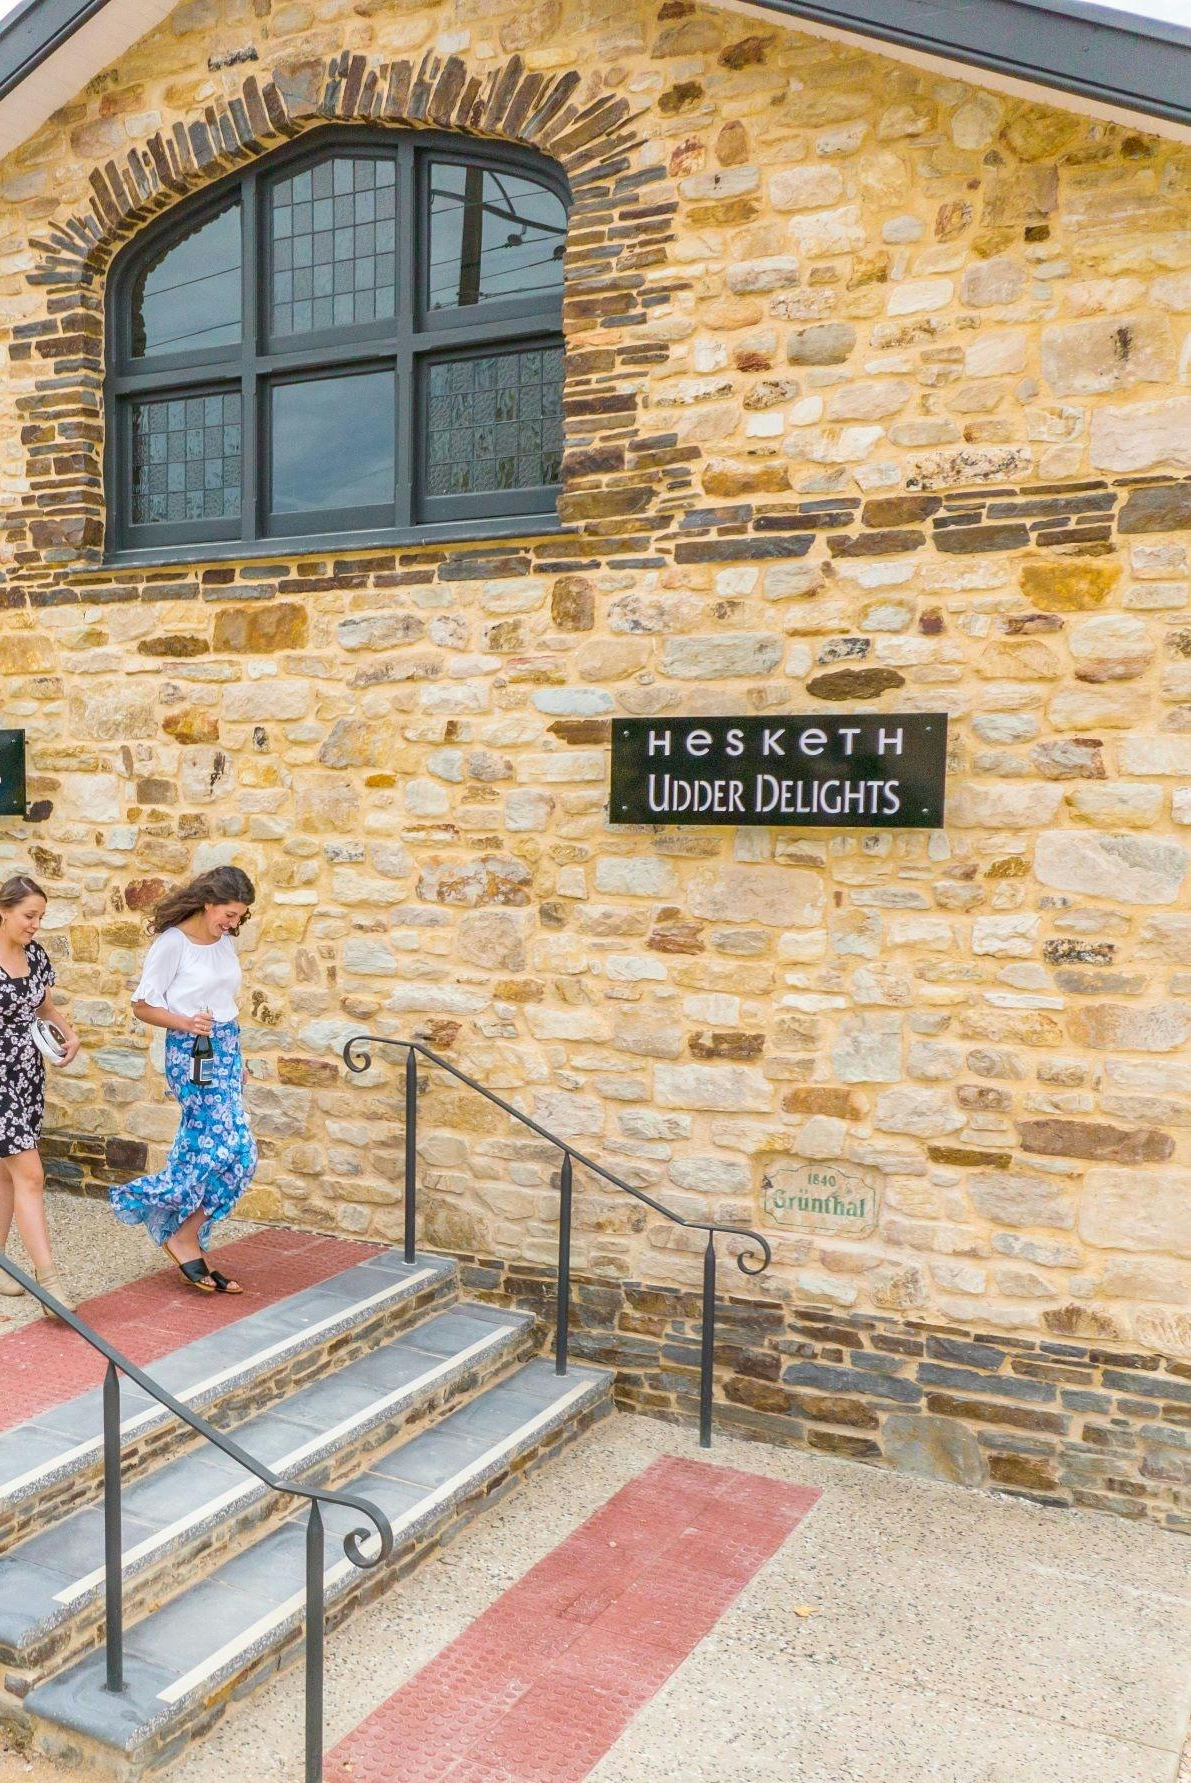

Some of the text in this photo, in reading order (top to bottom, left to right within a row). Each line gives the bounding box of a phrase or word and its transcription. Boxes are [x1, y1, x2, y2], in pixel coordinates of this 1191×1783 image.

[648, 774, 901, 815] UDDER DELIGHTS
[807, 1173, 836, 1187] 1840
[773, 1188, 866, 1218] Grünthal
